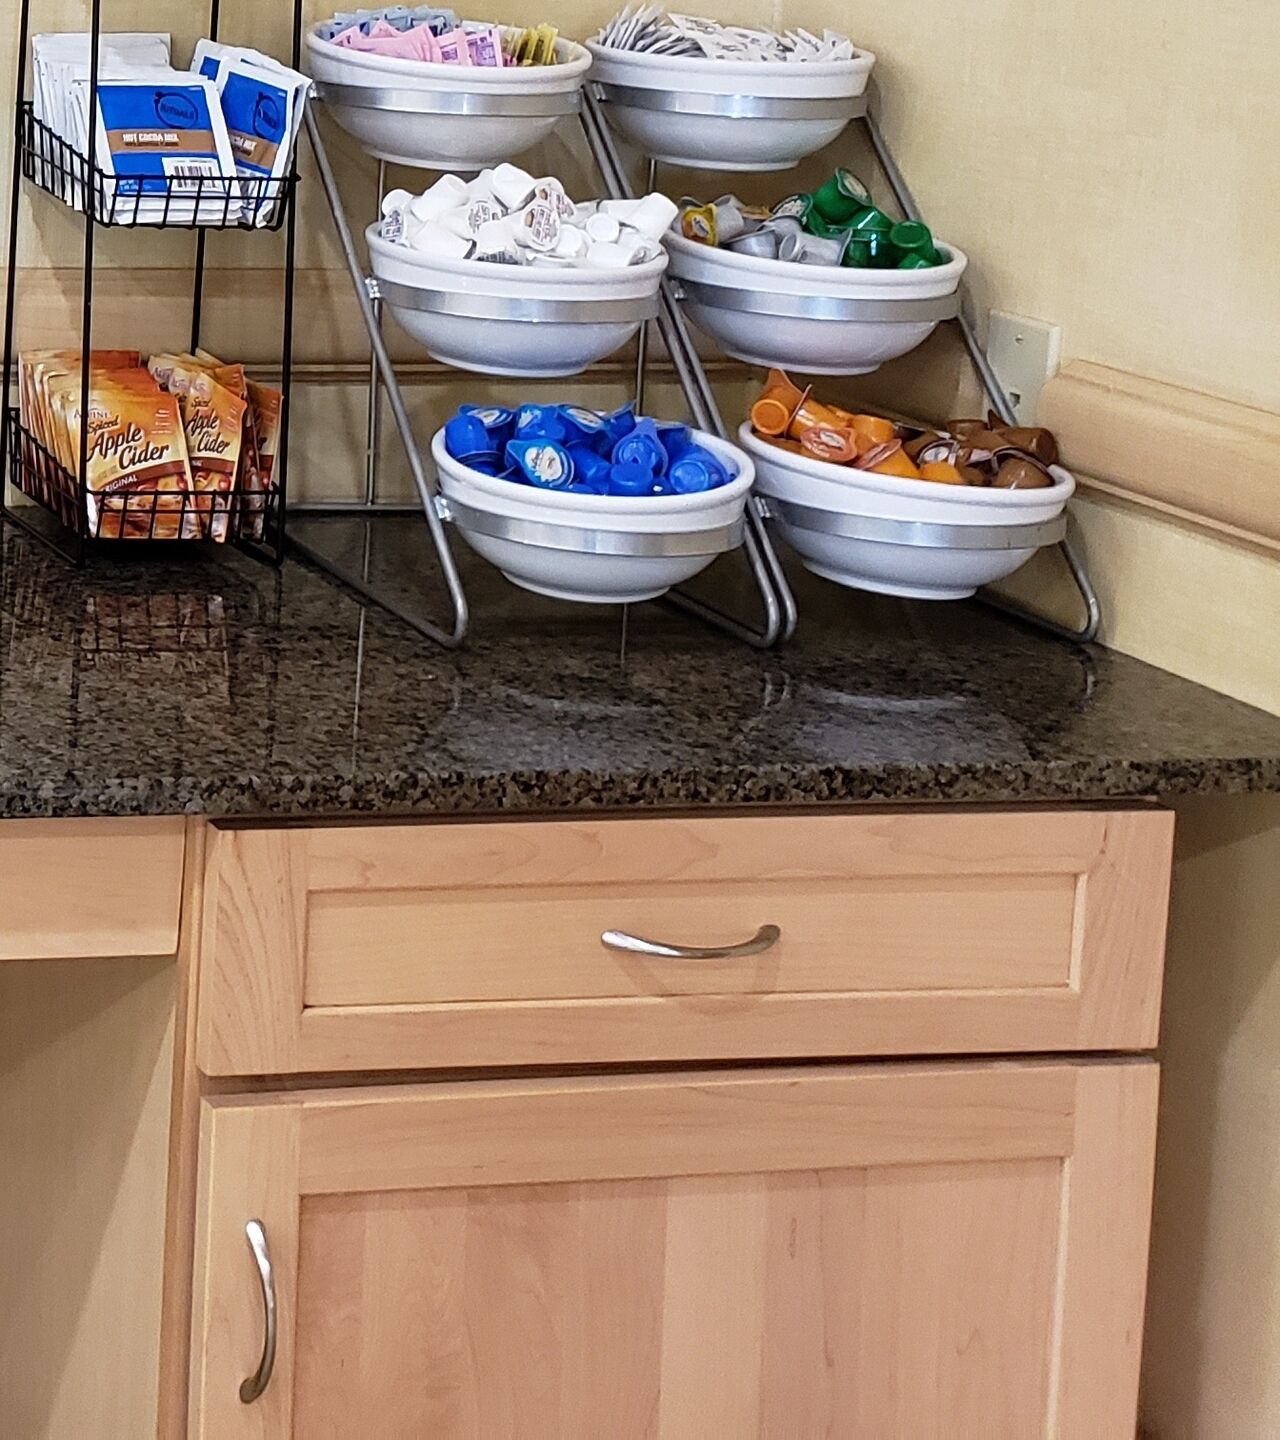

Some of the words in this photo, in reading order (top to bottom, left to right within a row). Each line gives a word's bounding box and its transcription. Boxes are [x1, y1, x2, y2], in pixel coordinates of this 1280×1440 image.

[87, 414, 120, 435] Spiced
[184, 408, 218, 436] Apple
[87, 422, 143, 462] Apple
[196, 431, 231, 454] Cider
[118, 440, 170, 470] Cider
[104, 474, 138, 491] RIGINAL
